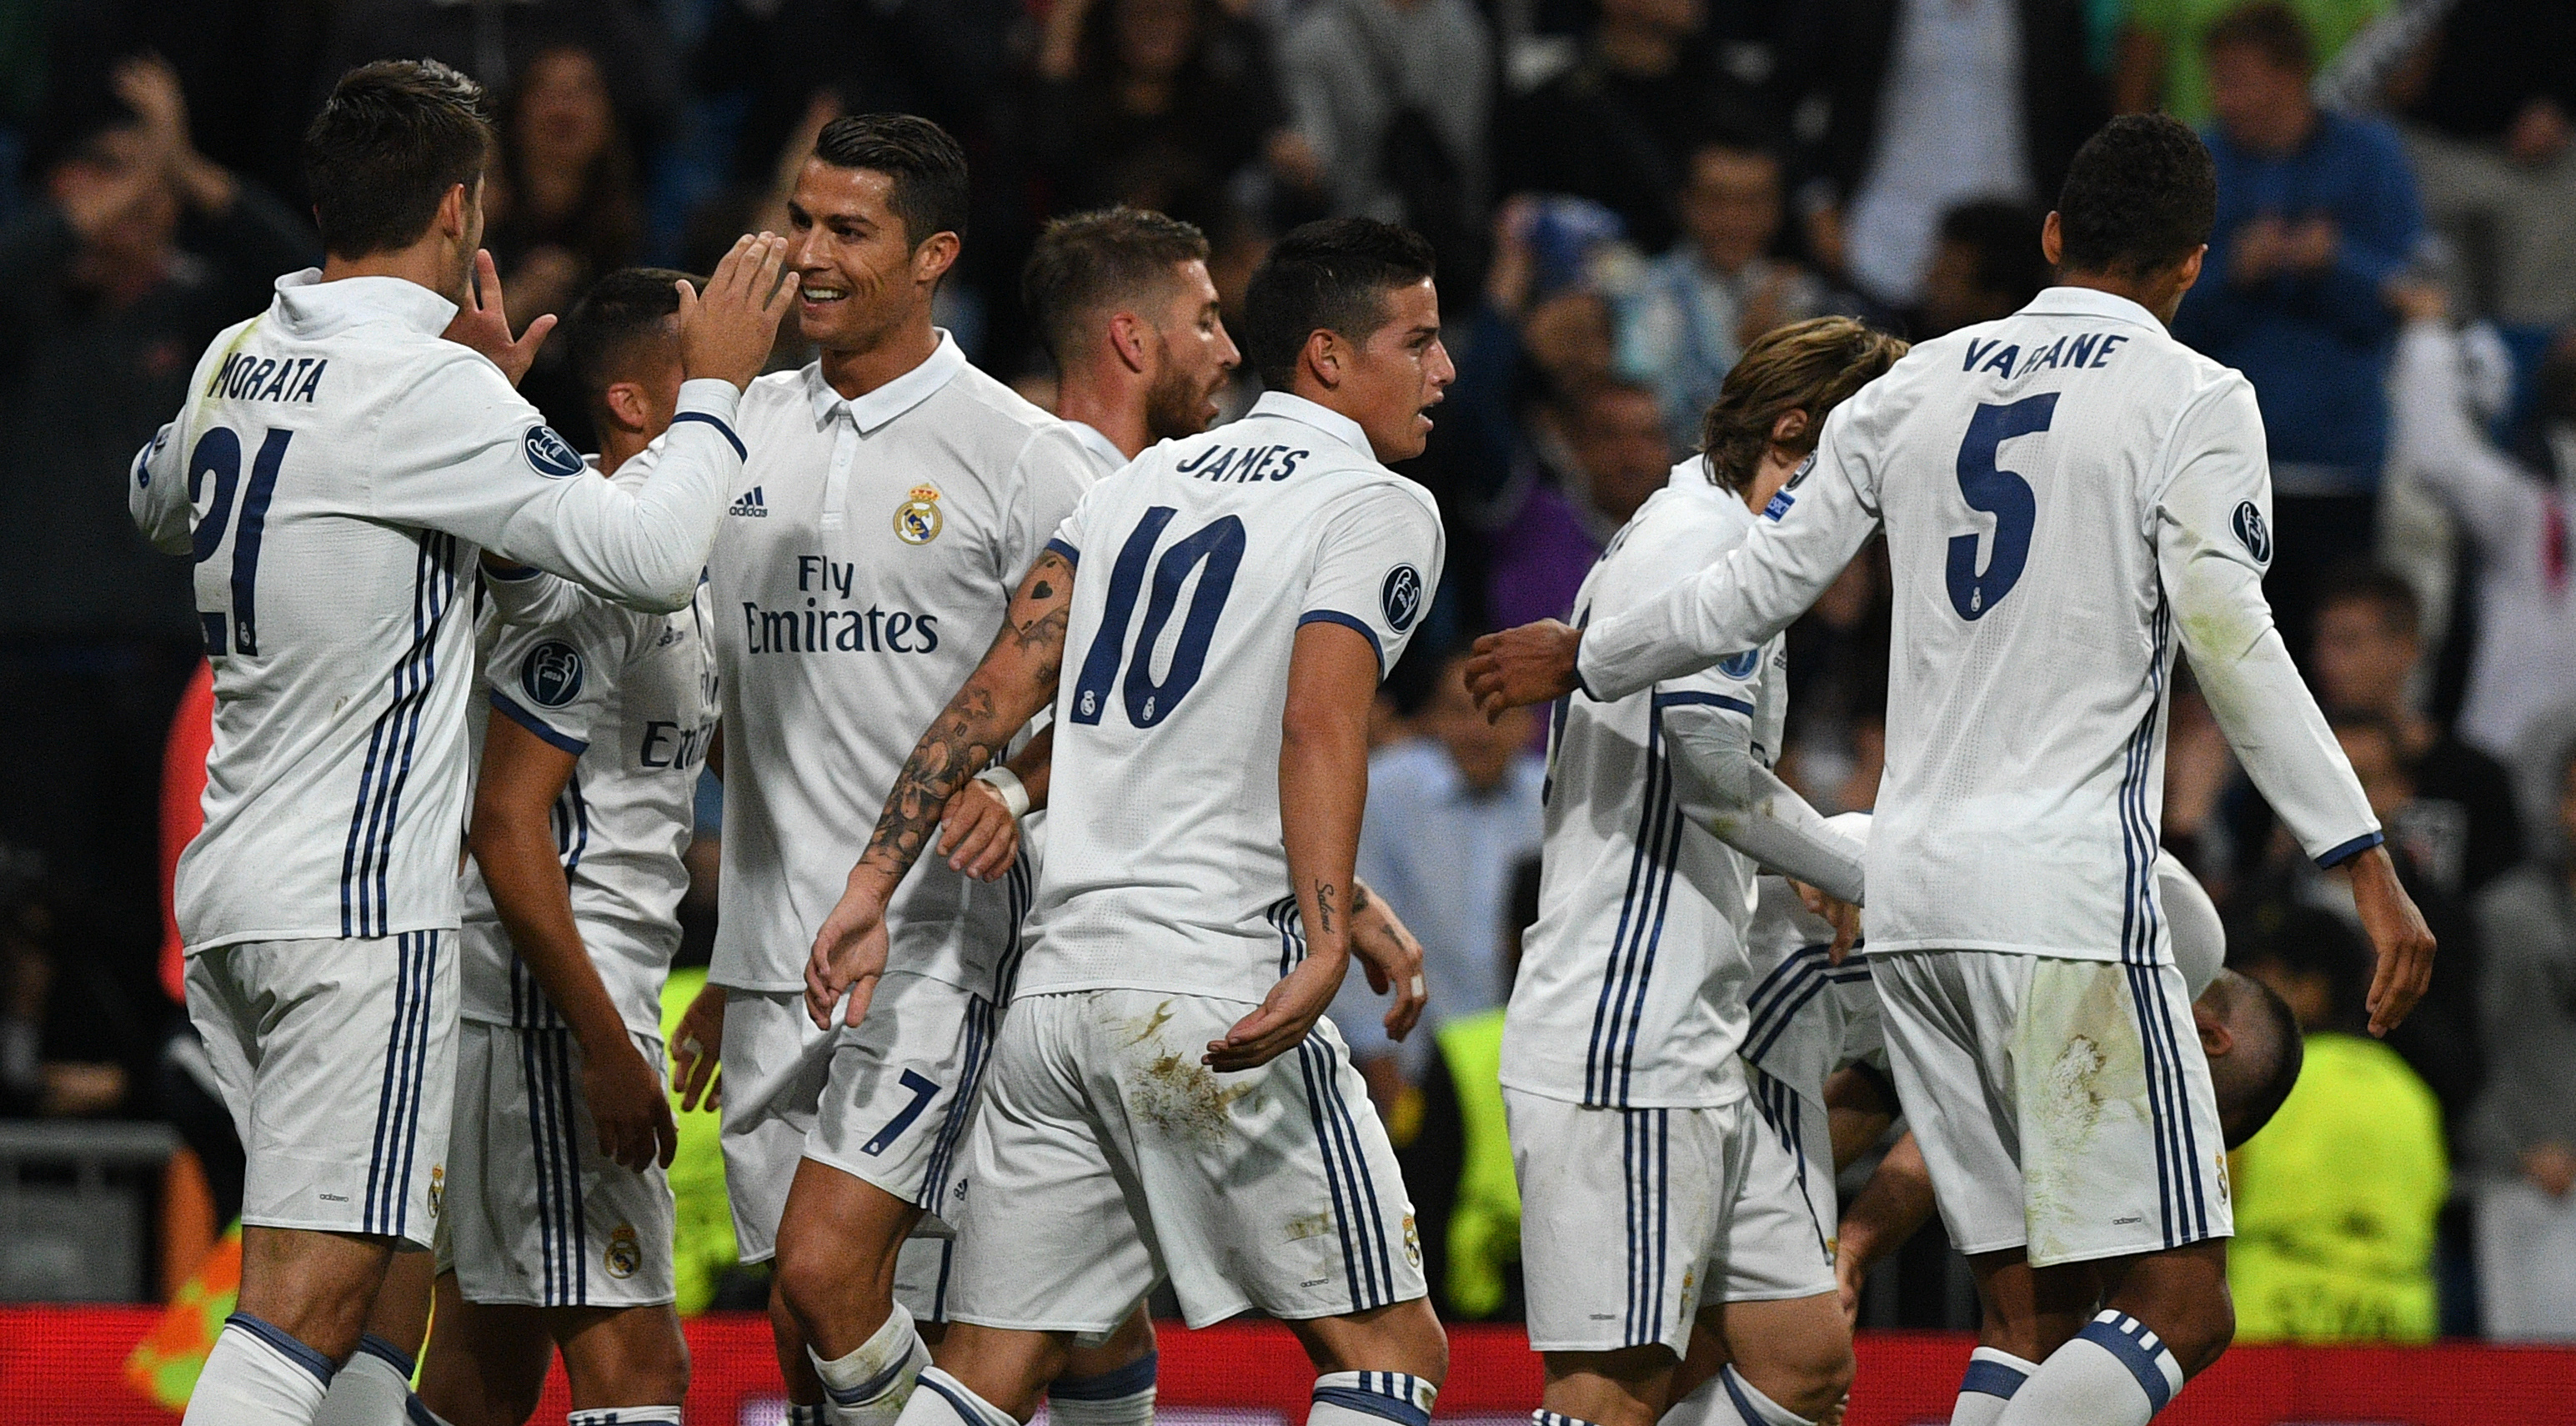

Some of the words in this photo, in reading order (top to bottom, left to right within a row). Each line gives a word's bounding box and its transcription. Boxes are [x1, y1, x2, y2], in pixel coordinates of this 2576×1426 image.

[207, 353, 328, 404] MORATA
[1176, 444, 1310, 483] JAMES
[729, 505, 768, 518] adidas
[1944, 392, 2062, 622] 5
[188, 426, 294, 657] 21
[796, 555, 854, 600] Fly
[741, 596, 940, 654] Emirates
[1069, 505, 1246, 729] 10
[860, 1067, 942, 1157] 7
